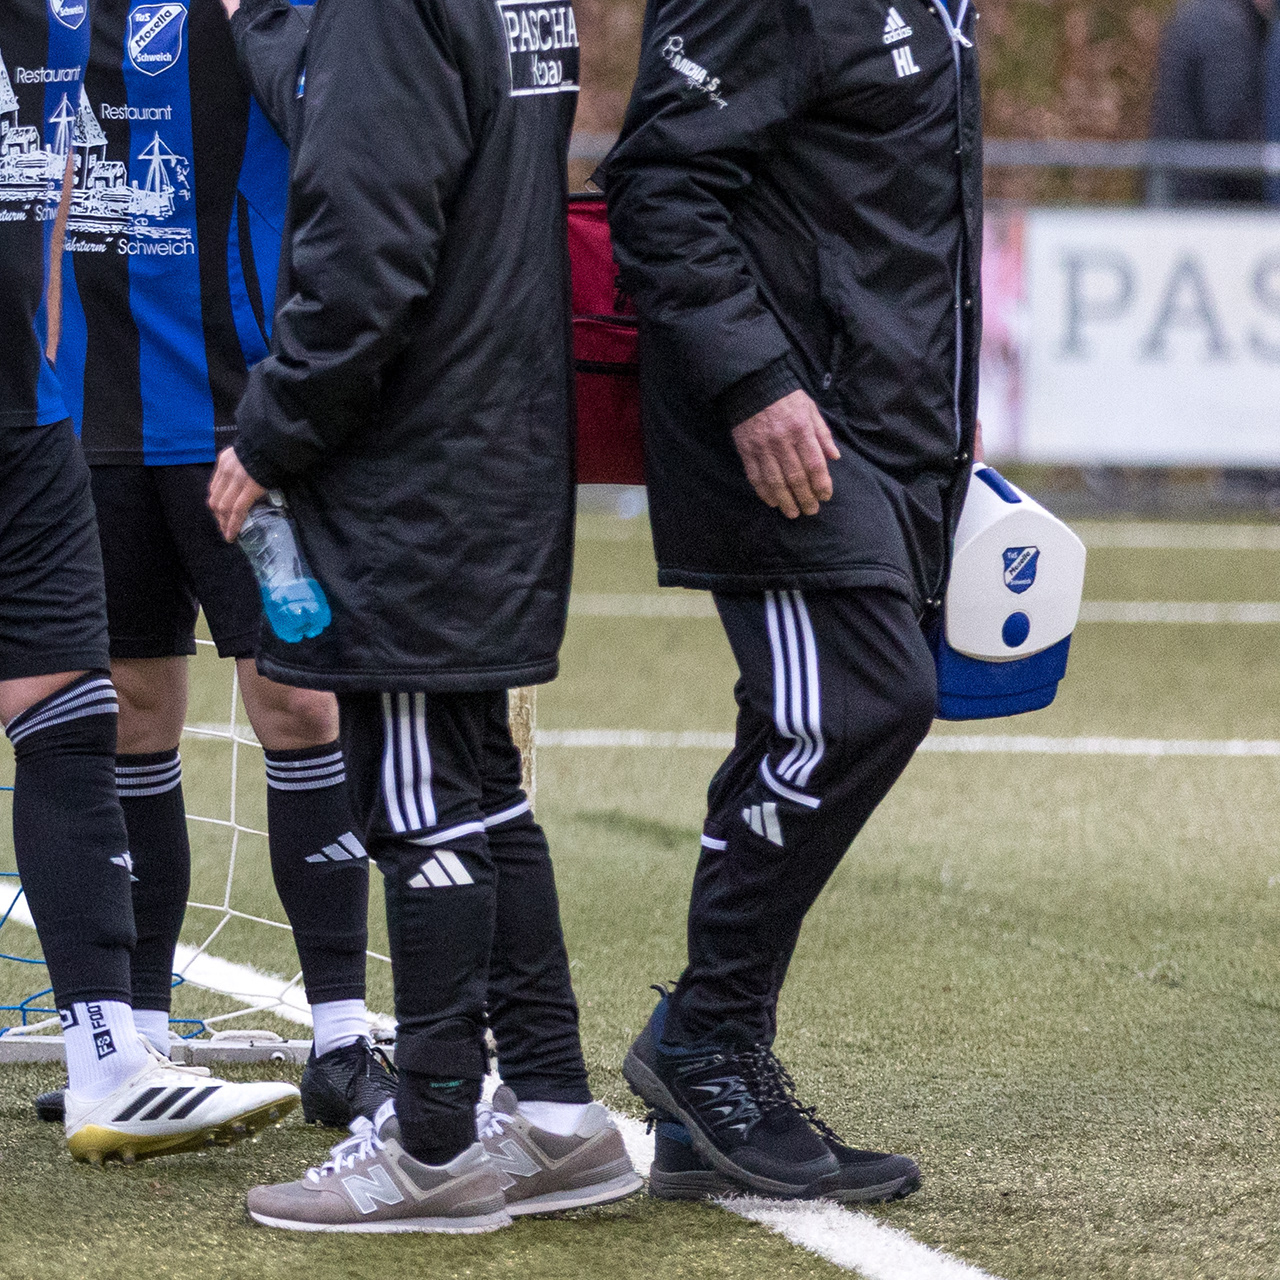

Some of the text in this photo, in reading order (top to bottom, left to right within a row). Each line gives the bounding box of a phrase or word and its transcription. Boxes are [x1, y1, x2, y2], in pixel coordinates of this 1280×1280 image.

[134, 9, 173, 49] Mosella
[891, 45, 921, 78] HL
[16, 65, 82, 84] Restaurant
[101, 103, 173, 121] Restaurant
[117, 238, 196, 256] Schweich
